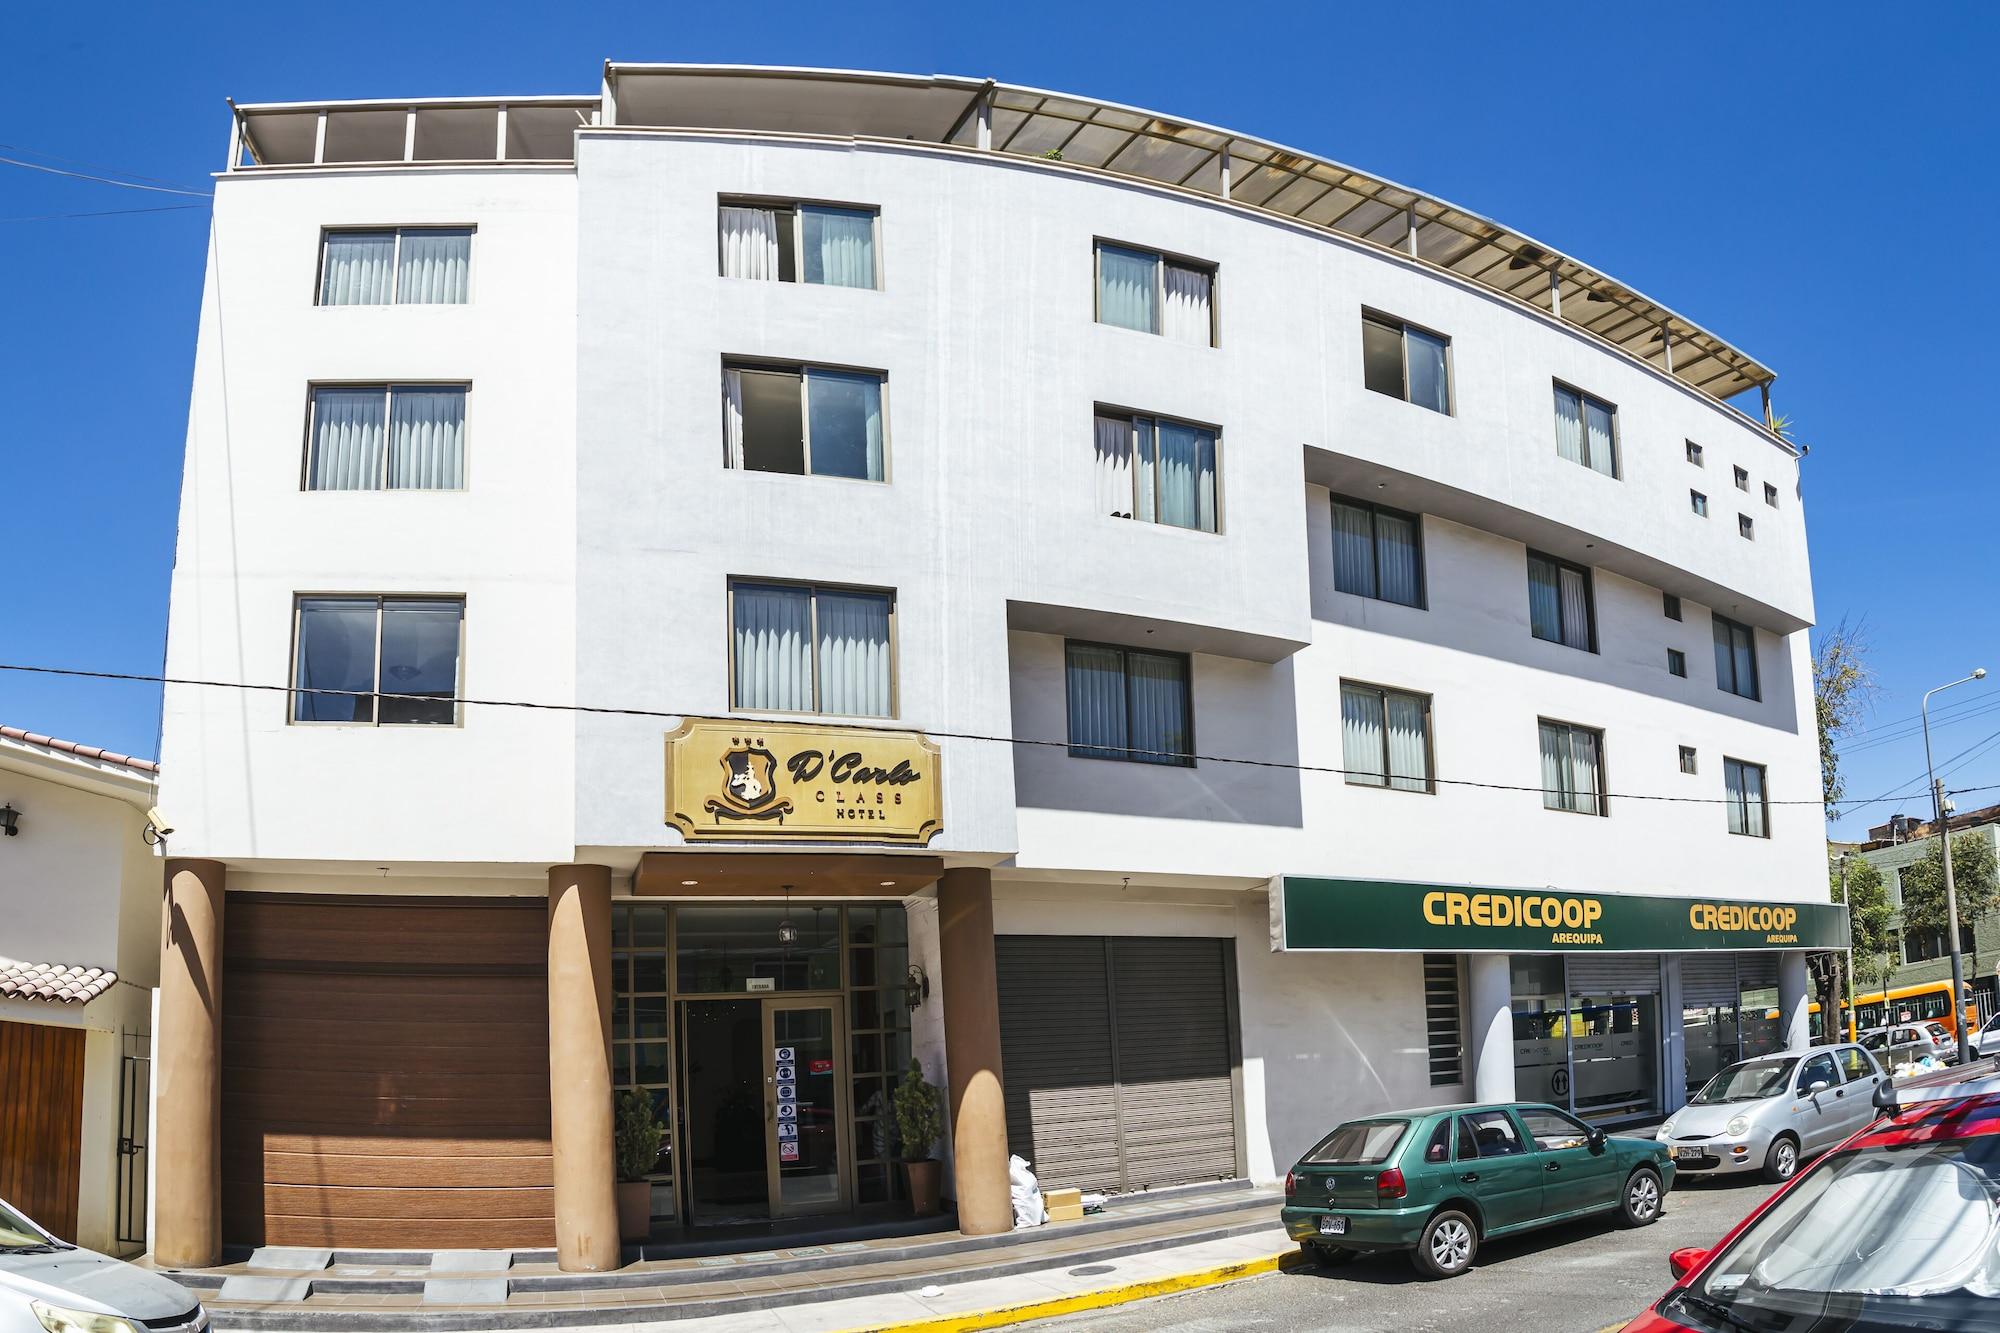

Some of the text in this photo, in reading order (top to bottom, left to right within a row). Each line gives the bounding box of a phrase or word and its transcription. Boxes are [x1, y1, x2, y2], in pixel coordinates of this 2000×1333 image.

[787, 750, 921, 786] D'Carlo
[815, 790, 902, 805] CLASS
[836, 808, 886, 821] HOTEL
[1422, 890, 1602, 928] CREDICOOP
[1689, 904, 1797, 931] CREDICOOP
[1551, 932, 1602, 945] AREQUIPA
[1766, 933, 1797, 944] AREQUIPA
